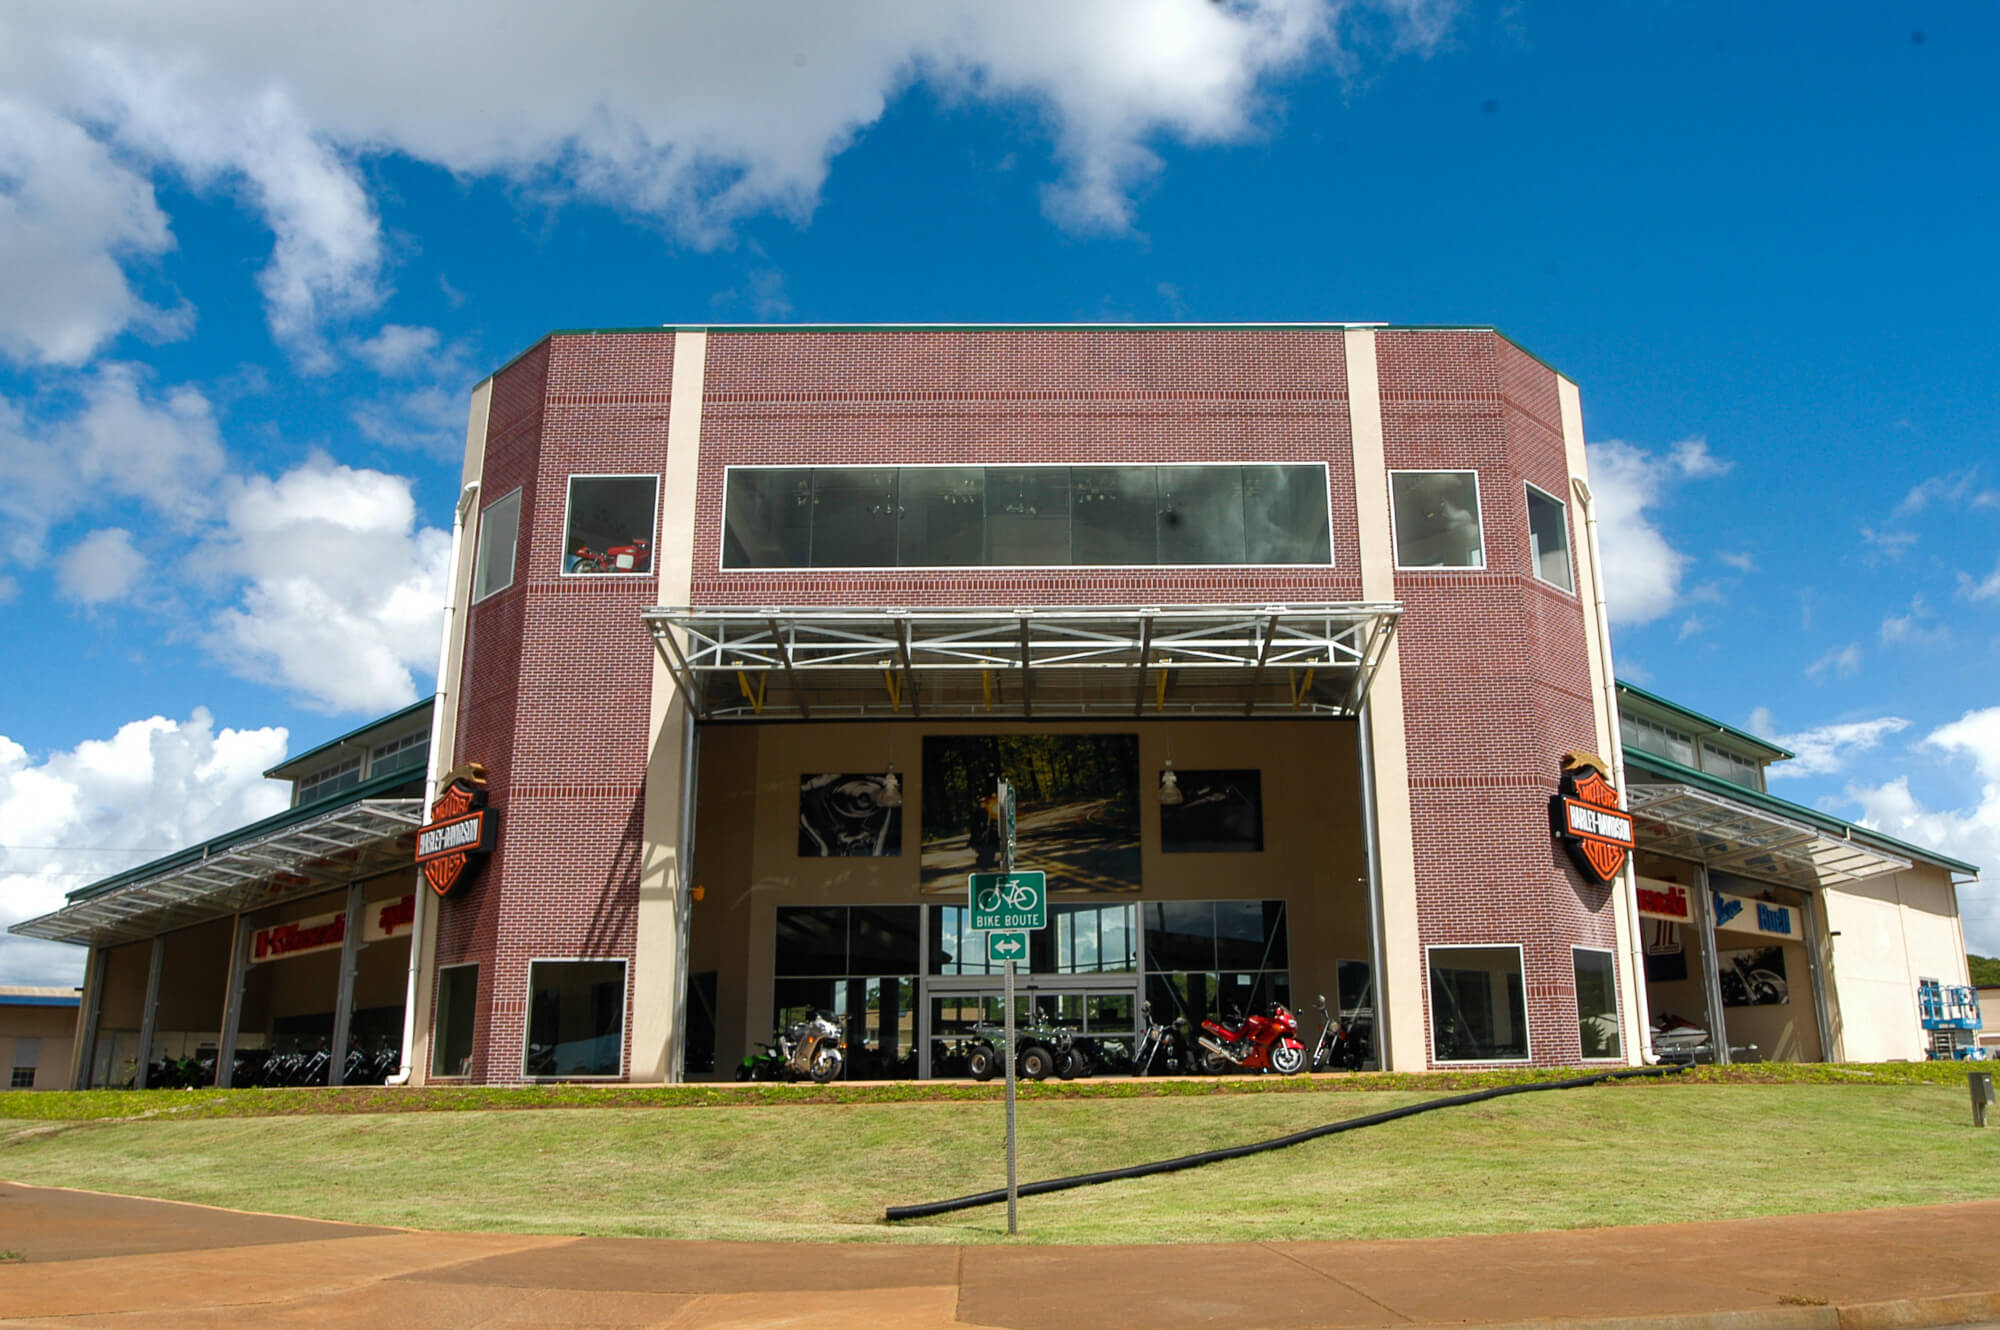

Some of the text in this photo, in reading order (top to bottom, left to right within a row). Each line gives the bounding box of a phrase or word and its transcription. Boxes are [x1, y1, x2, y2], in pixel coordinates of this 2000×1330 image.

[976, 913, 1039, 928] BIKE ROUTE
[1756, 903, 1791, 934] Buell
